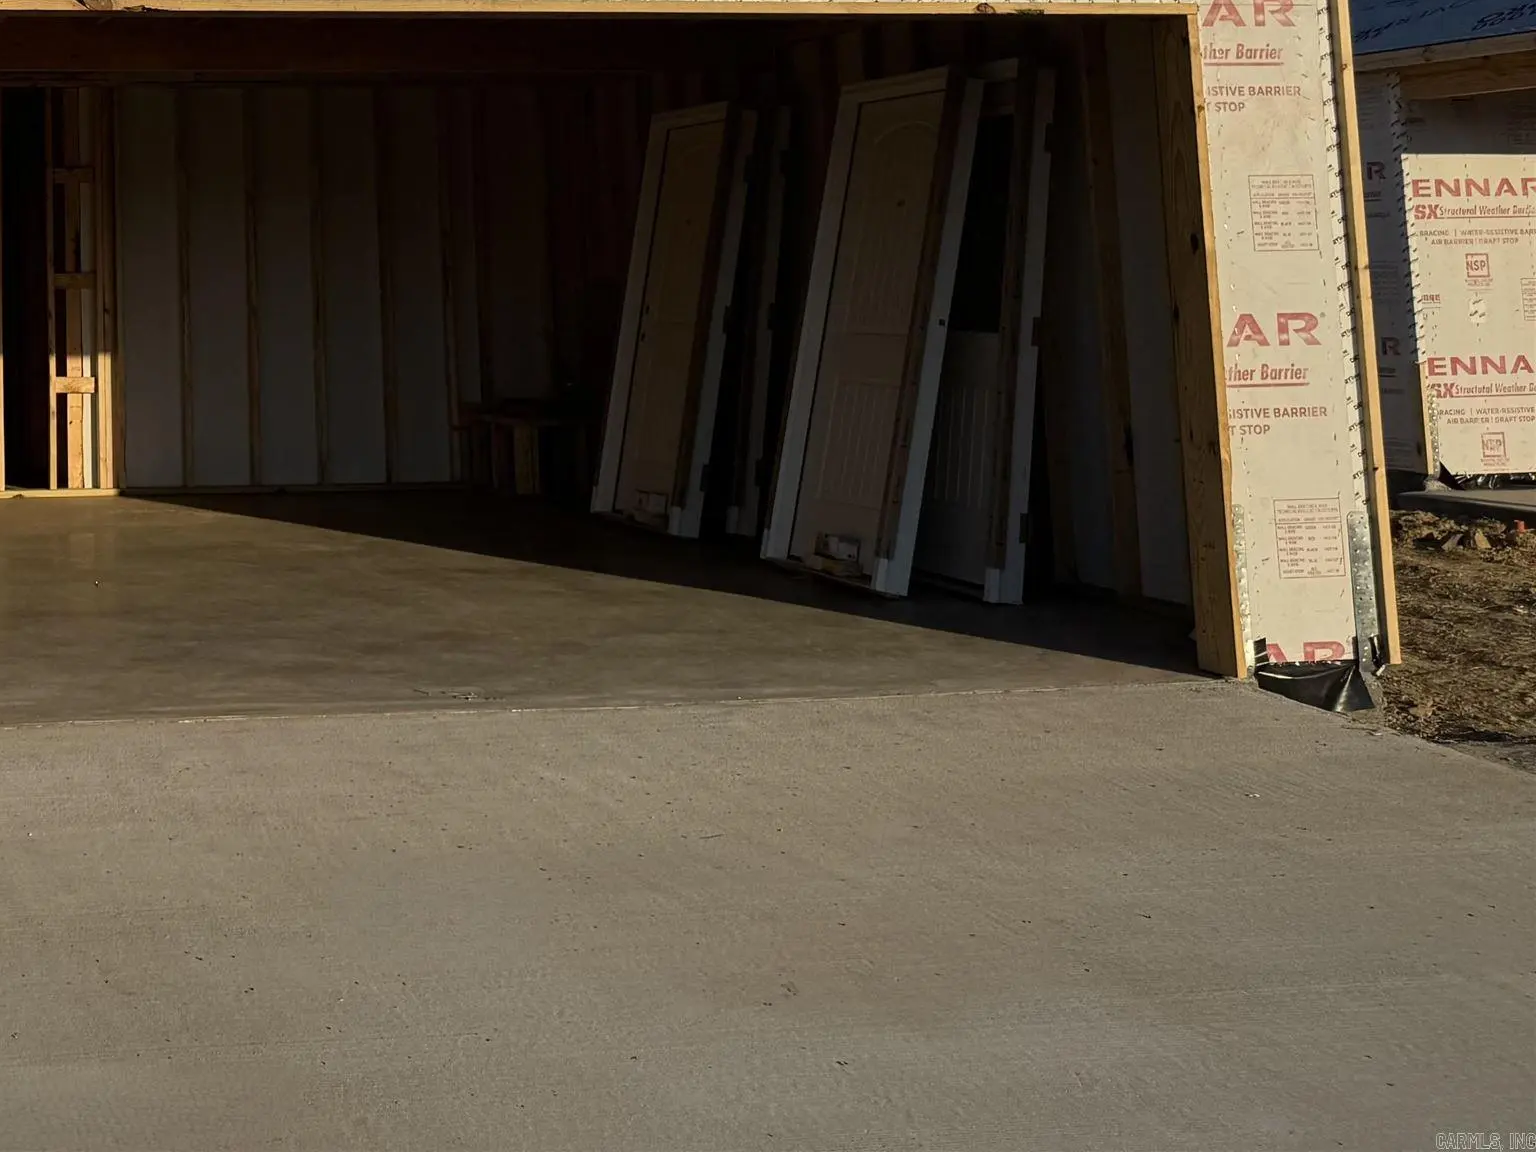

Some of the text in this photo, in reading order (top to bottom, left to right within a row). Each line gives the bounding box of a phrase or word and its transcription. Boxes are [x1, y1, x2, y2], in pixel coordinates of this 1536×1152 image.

[1236, 43, 1283, 61] Barrier
[1248, 86, 1301, 97] BARRIER
[1214, 101, 1245, 112] STOP
[1466, 260, 1486, 272] NSP
[1226, 312, 1322, 347] AR
[1427, 355, 1534, 376] ENNA
[1260, 364, 1309, 383] Barrier
[1273, 406, 1327, 418] BARRIER
[1239, 424, 1271, 435] STOP
